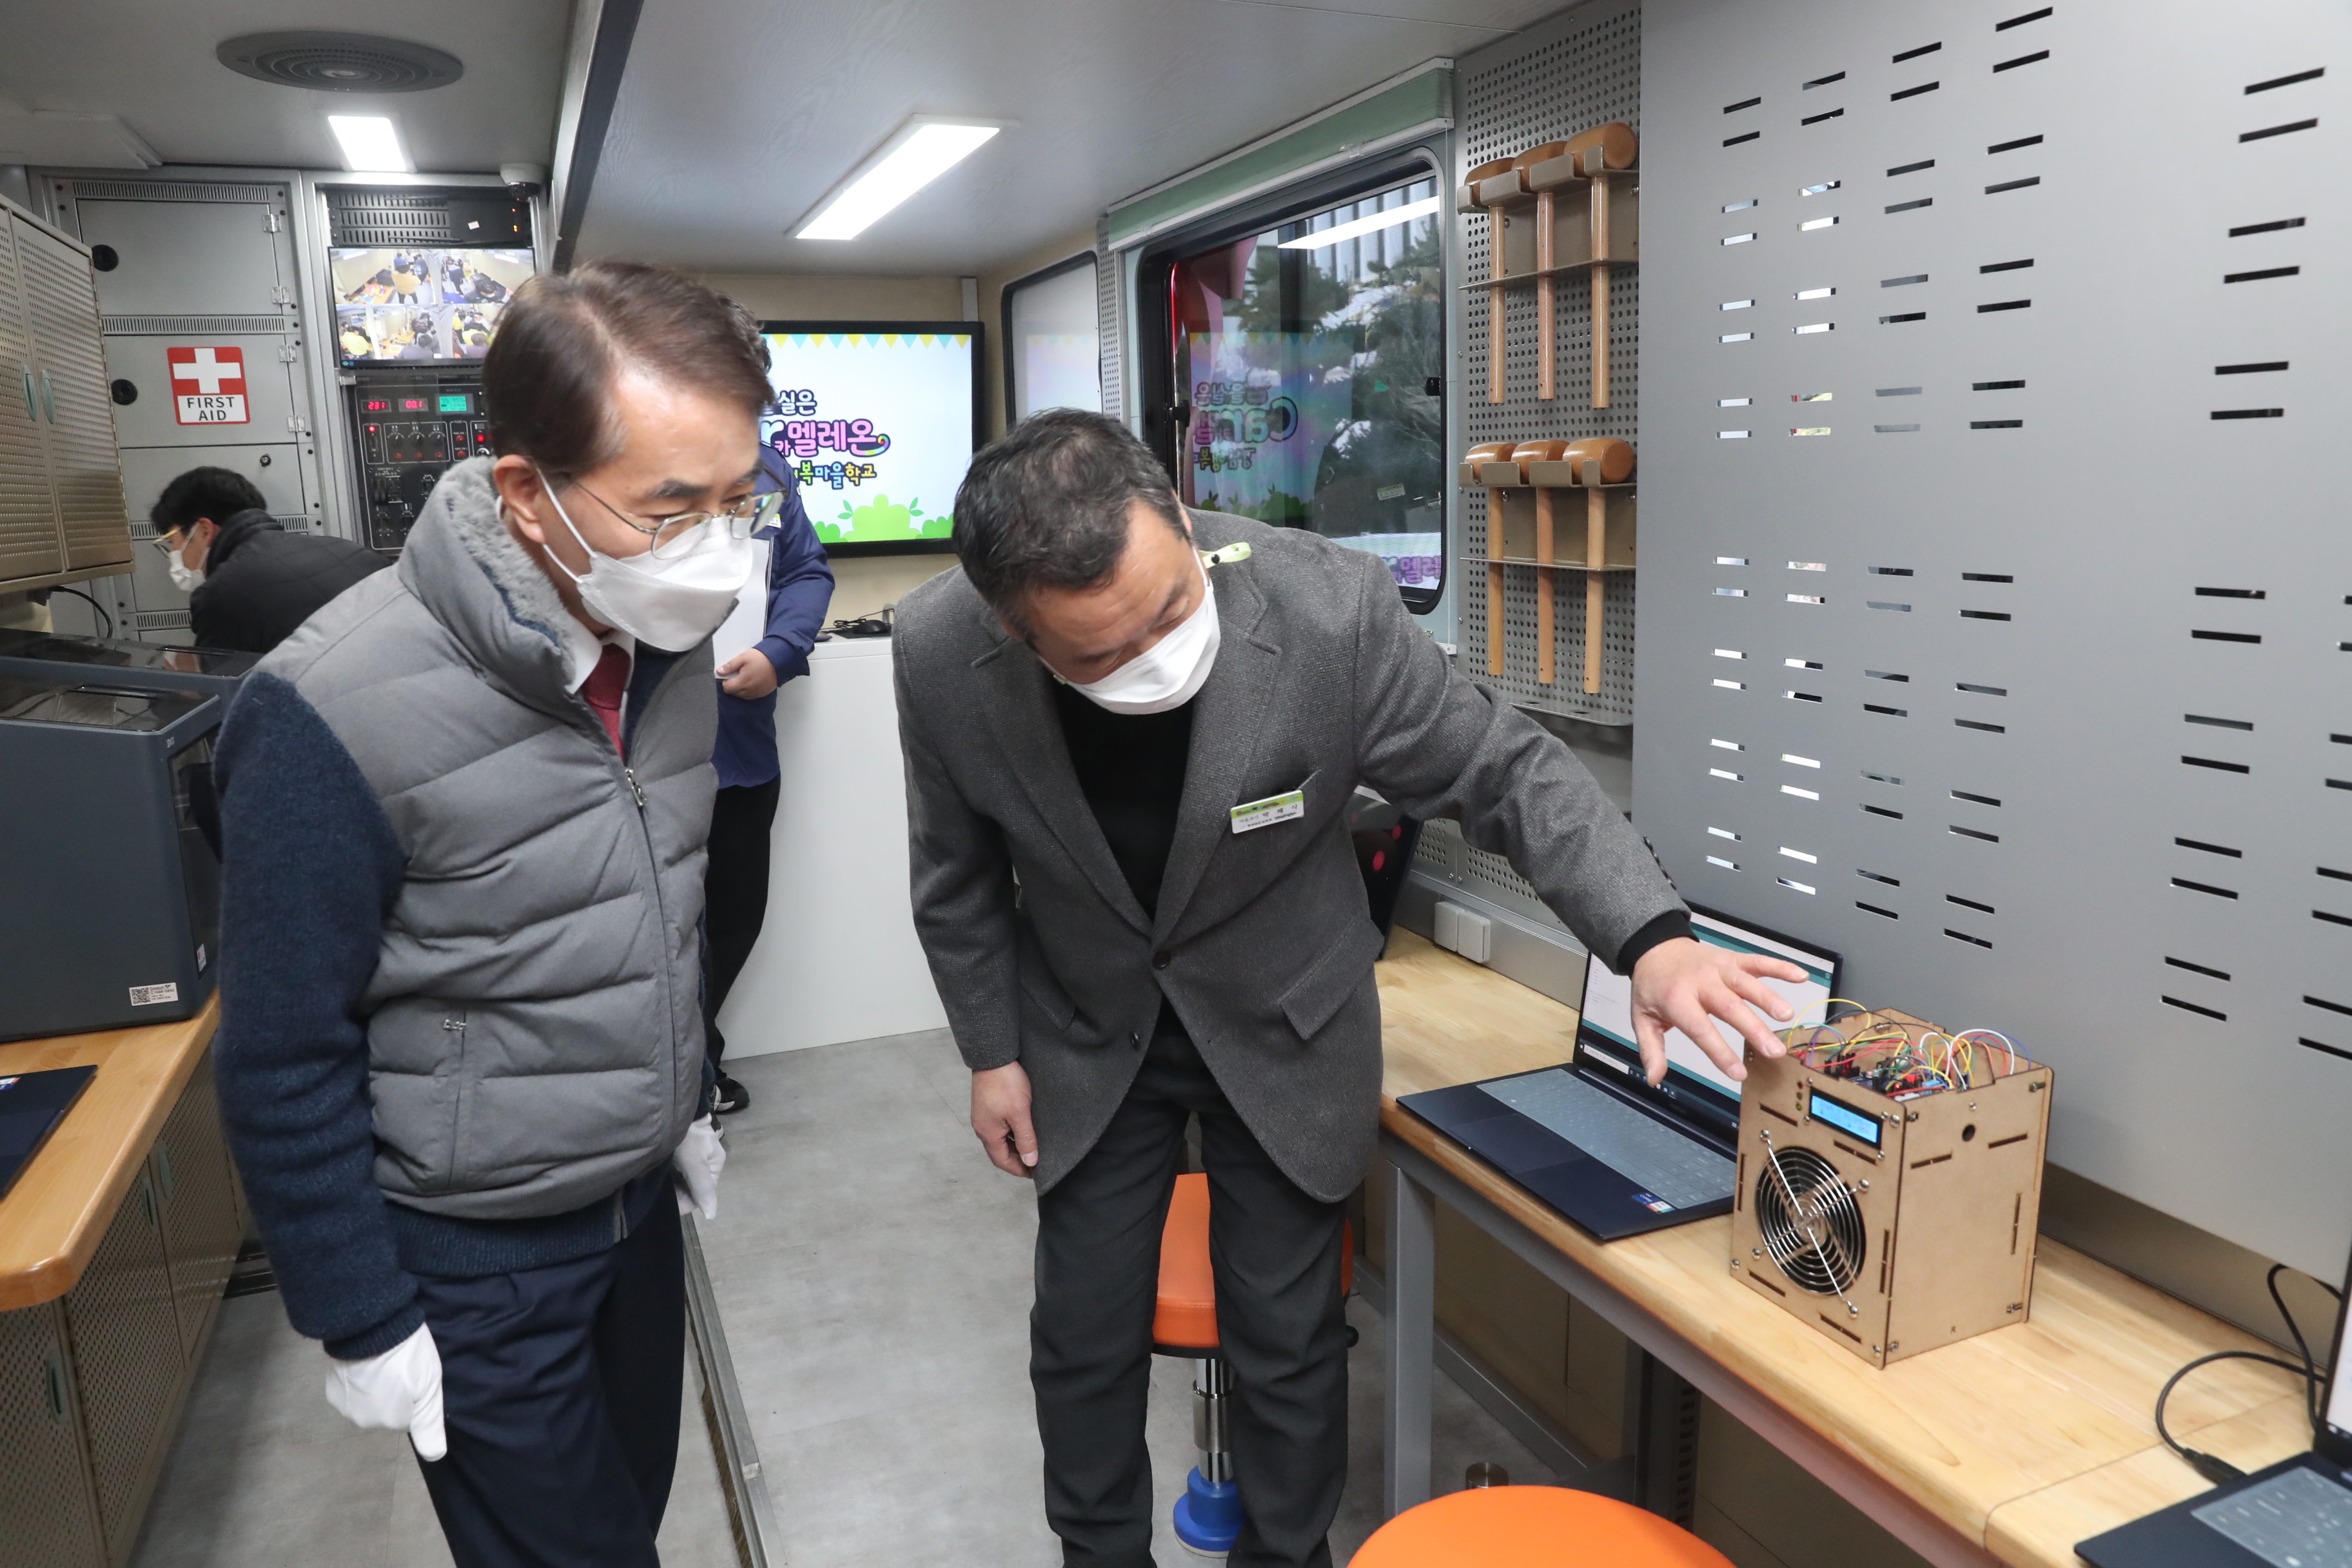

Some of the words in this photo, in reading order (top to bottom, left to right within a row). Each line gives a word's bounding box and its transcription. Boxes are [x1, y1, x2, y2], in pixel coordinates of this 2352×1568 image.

[187, 397, 235, 409] FIRST
[368, 401, 386, 410] 231
[778, 389, 817, 416] 실은
[199, 410, 227, 421] AID
[794, 460, 877, 490] 복마을학교
